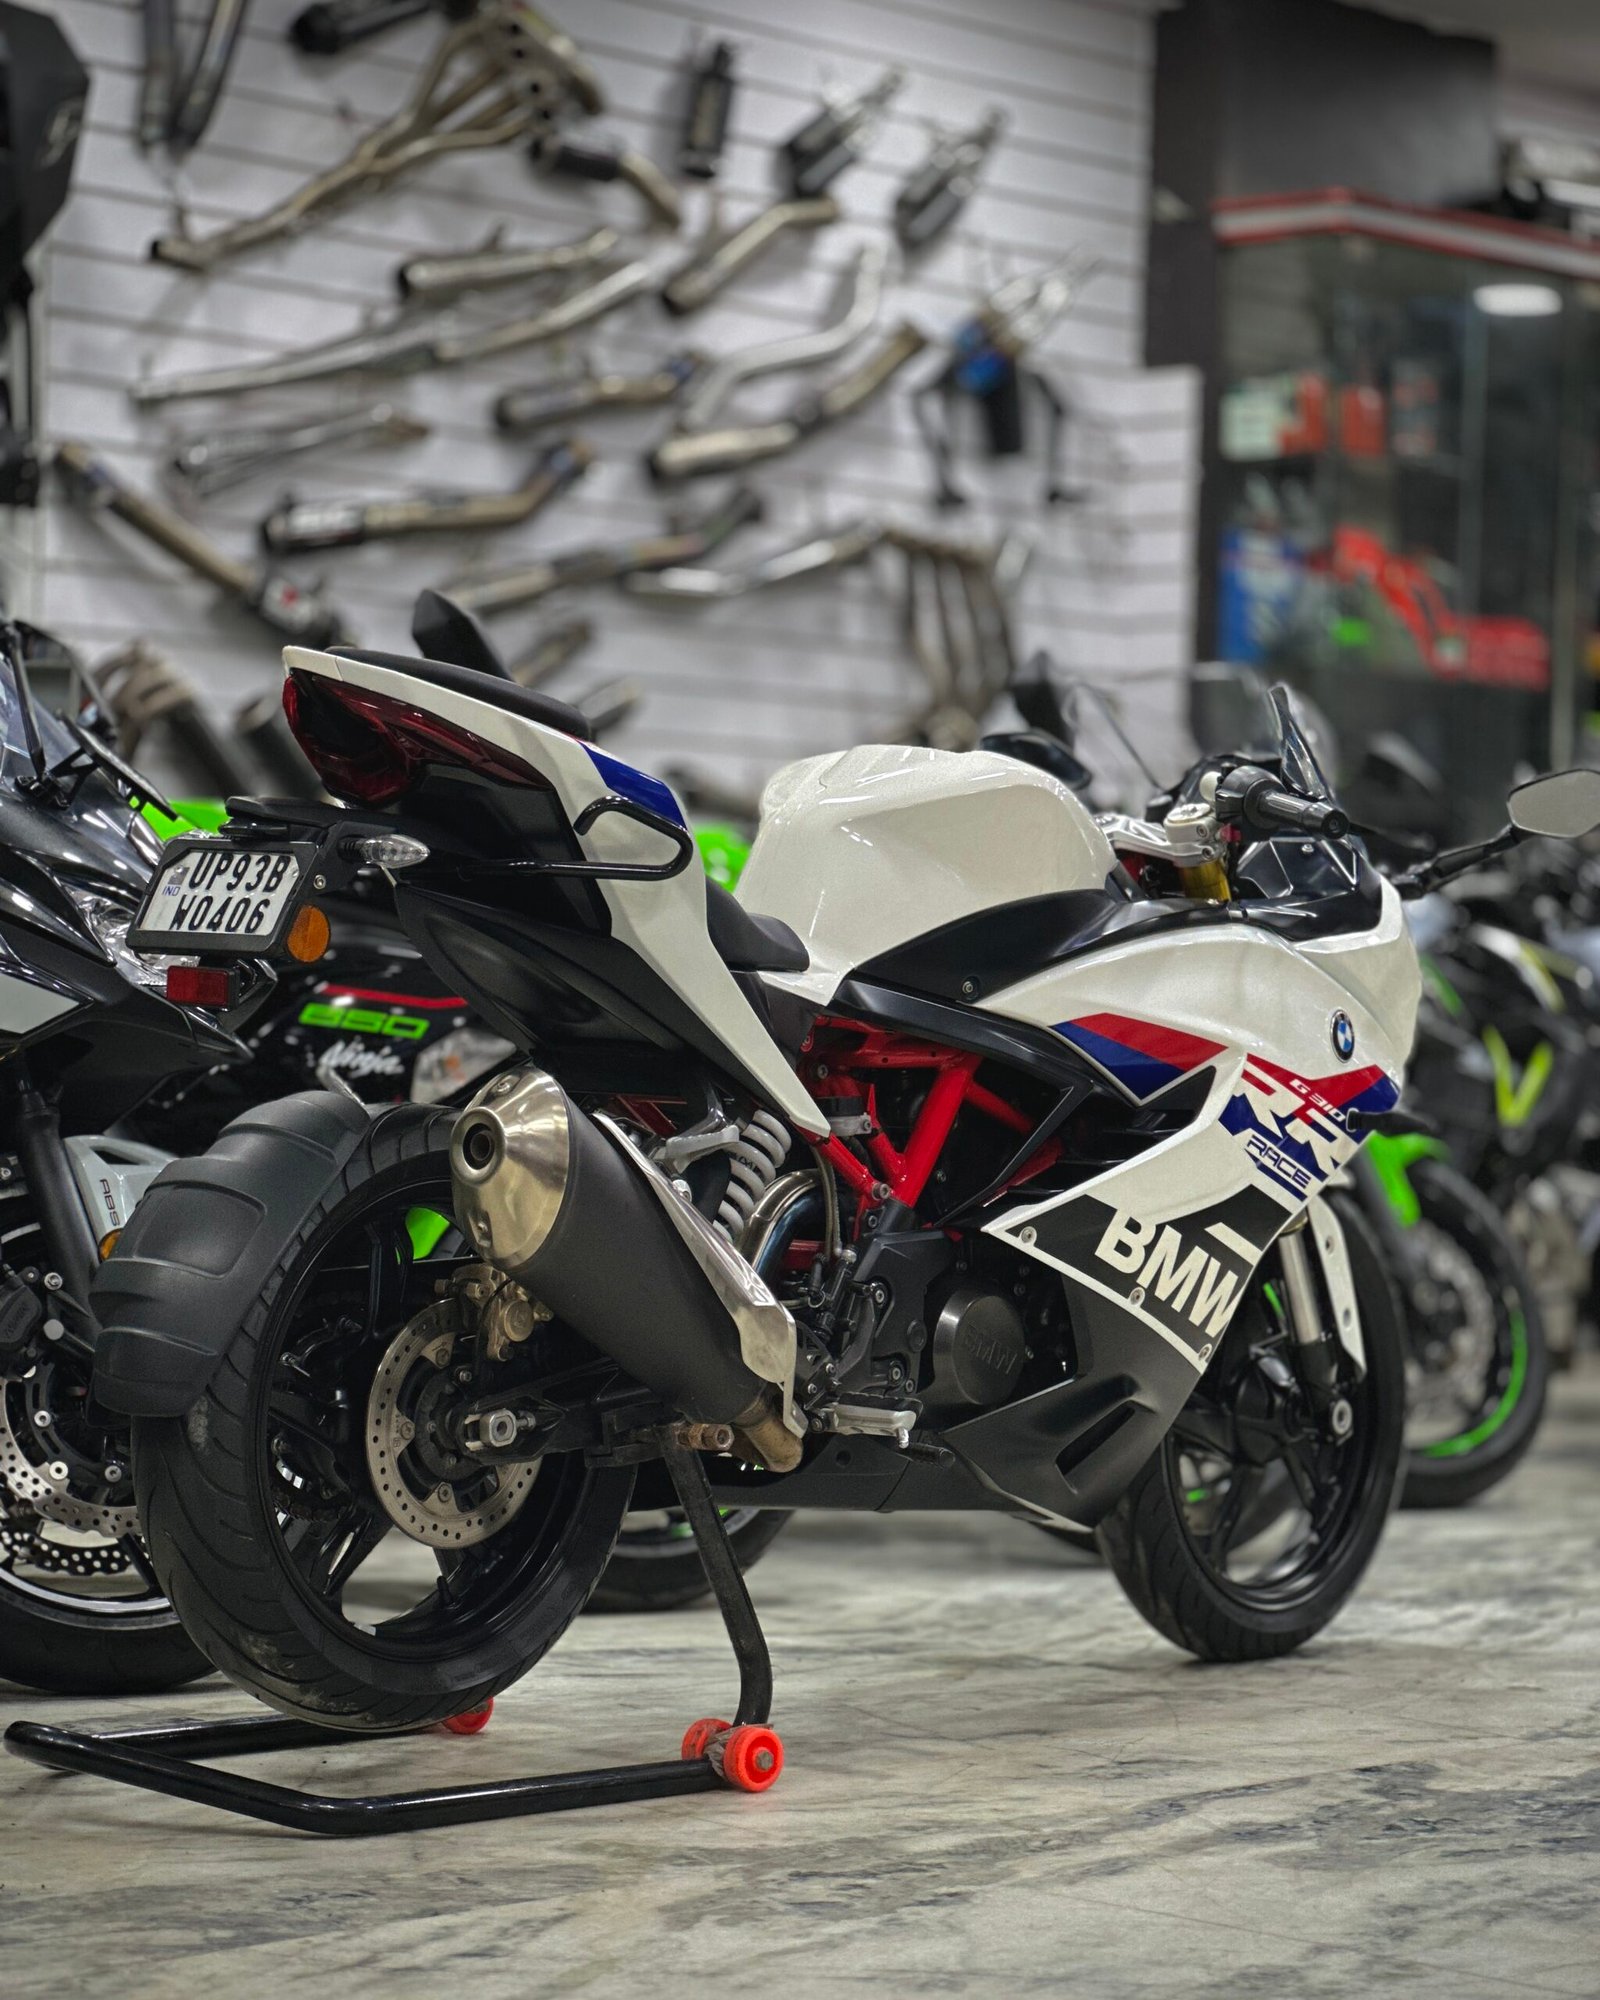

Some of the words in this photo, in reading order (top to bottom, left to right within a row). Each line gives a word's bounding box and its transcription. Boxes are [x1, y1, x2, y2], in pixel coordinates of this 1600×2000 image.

[162, 885, 181, 897] IND
[189, 851, 291, 893] UP93B
[169, 894, 270, 934] W0406
[299, 1002, 430, 1039] 650
[318, 1036, 404, 1078] Ninja
[1289, 1078, 1311, 1095] G
[1308, 1092, 1346, 1122] 310
[1246, 1134, 1312, 1189] RACE
[100, 1178, 120, 1227] ABS
[1094, 1208, 1242, 1338] BMW
